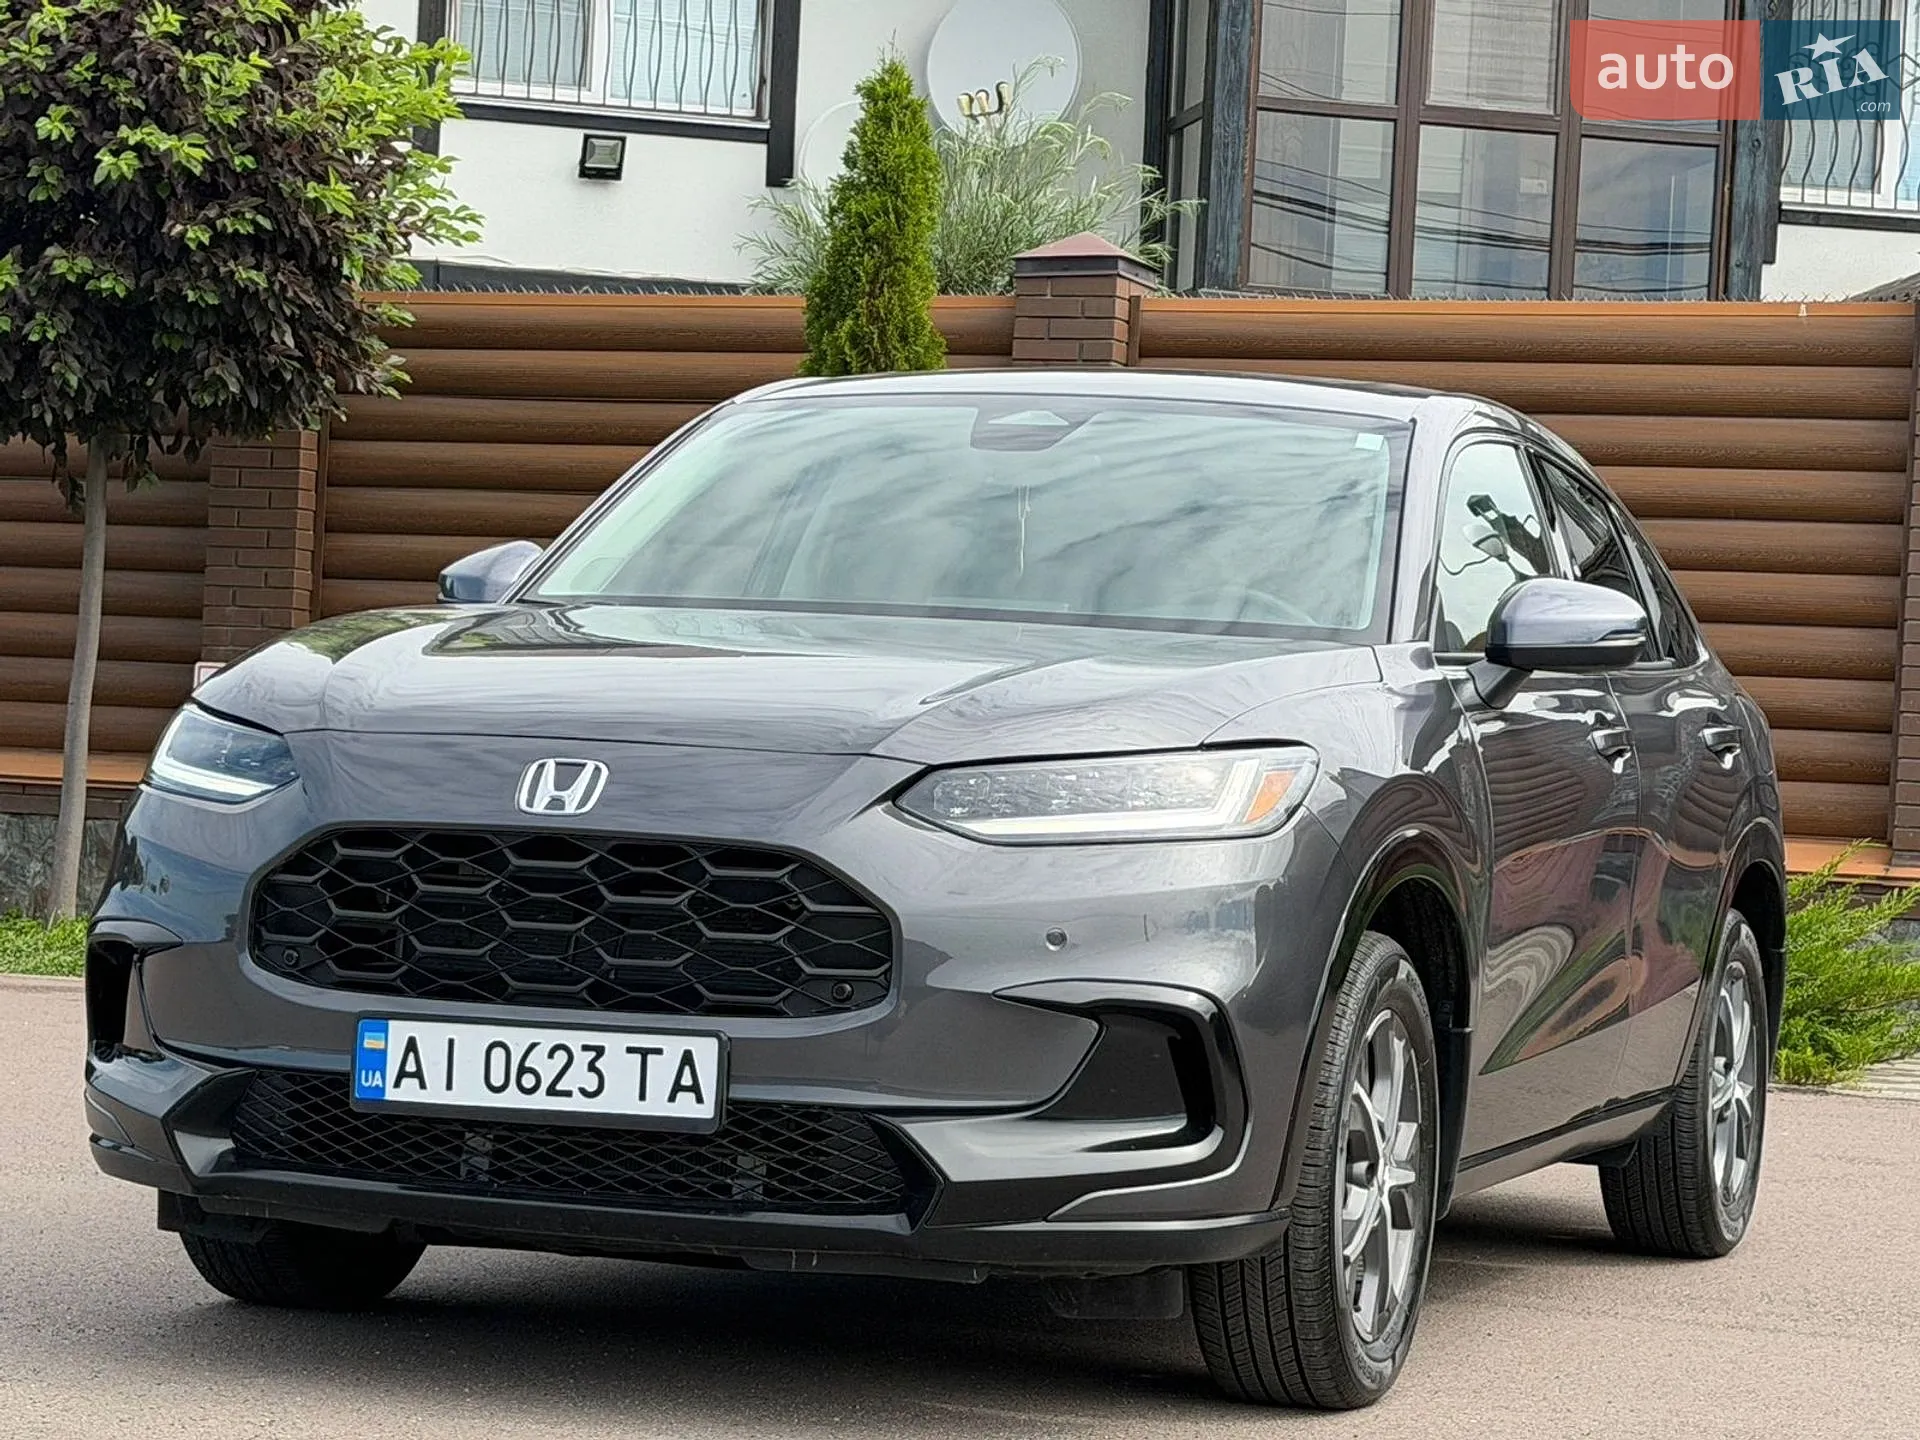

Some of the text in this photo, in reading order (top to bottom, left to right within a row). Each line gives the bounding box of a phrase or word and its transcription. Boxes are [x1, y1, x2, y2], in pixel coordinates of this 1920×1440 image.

[361, 1069, 384, 1089] UA
[393, 1035, 705, 1105] AI 0623 TA
